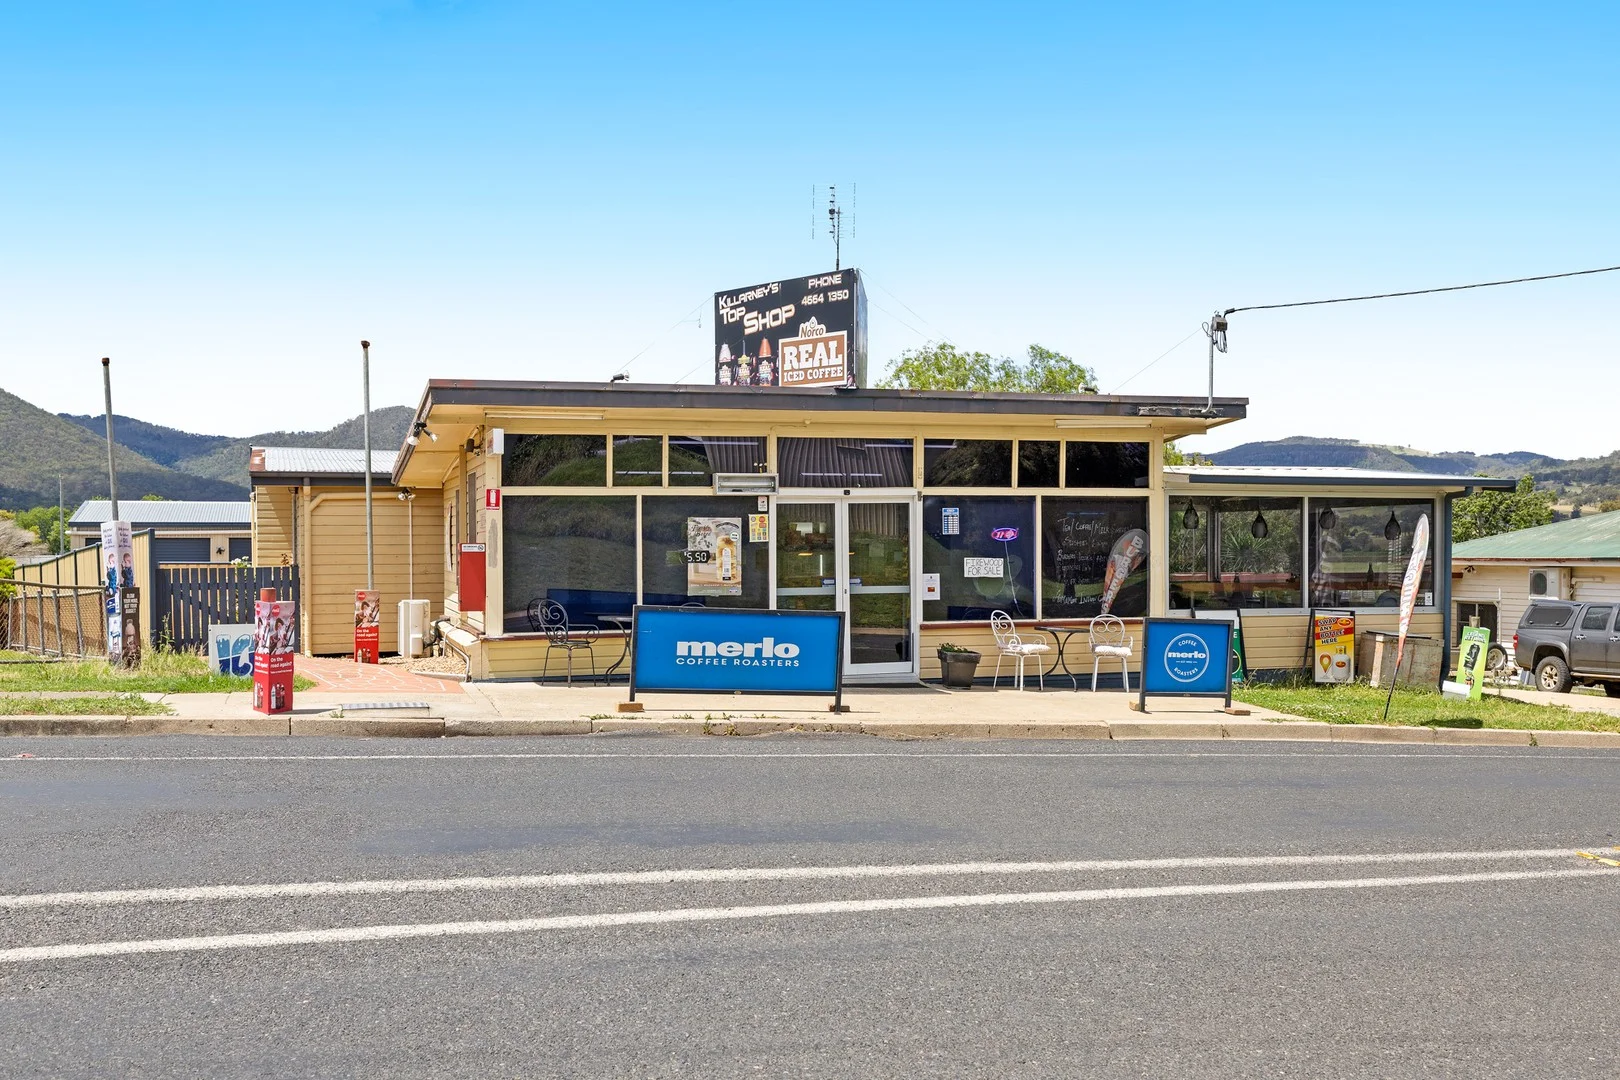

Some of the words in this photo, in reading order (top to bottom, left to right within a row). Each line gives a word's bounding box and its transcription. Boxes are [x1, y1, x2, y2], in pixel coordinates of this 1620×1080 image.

[808, 274, 842, 289] PHONE
[718, 282, 779, 309] KILLARNEY'S
[801, 293, 824, 306] 4664
[827, 289, 849, 302] 1350
[719, 306, 746, 325] TOP
[743, 303, 796, 336] SHOP
[800, 326, 824, 339] Norco
[783, 340, 843, 371] REAL
[783, 369, 805, 383] ICED
[807, 366, 843, 380] COFFEE
[965, 558, 1003, 567] FIREWOOD
[967, 566, 981, 576] FOR
[984, 566, 1001, 575] SALE
[1318, 618, 1337, 626] SWAP
[1320, 629, 1345, 638] BOTTLE
[676, 637, 800, 659] merlo
[1178, 639, 1198, 647] COFFEE
[216, 633, 255, 677] IC
[1167, 650, 1207, 659] merlo
[733, 659, 800, 667] ROASTERS
[1173, 666, 1199, 677] ROASTERS
